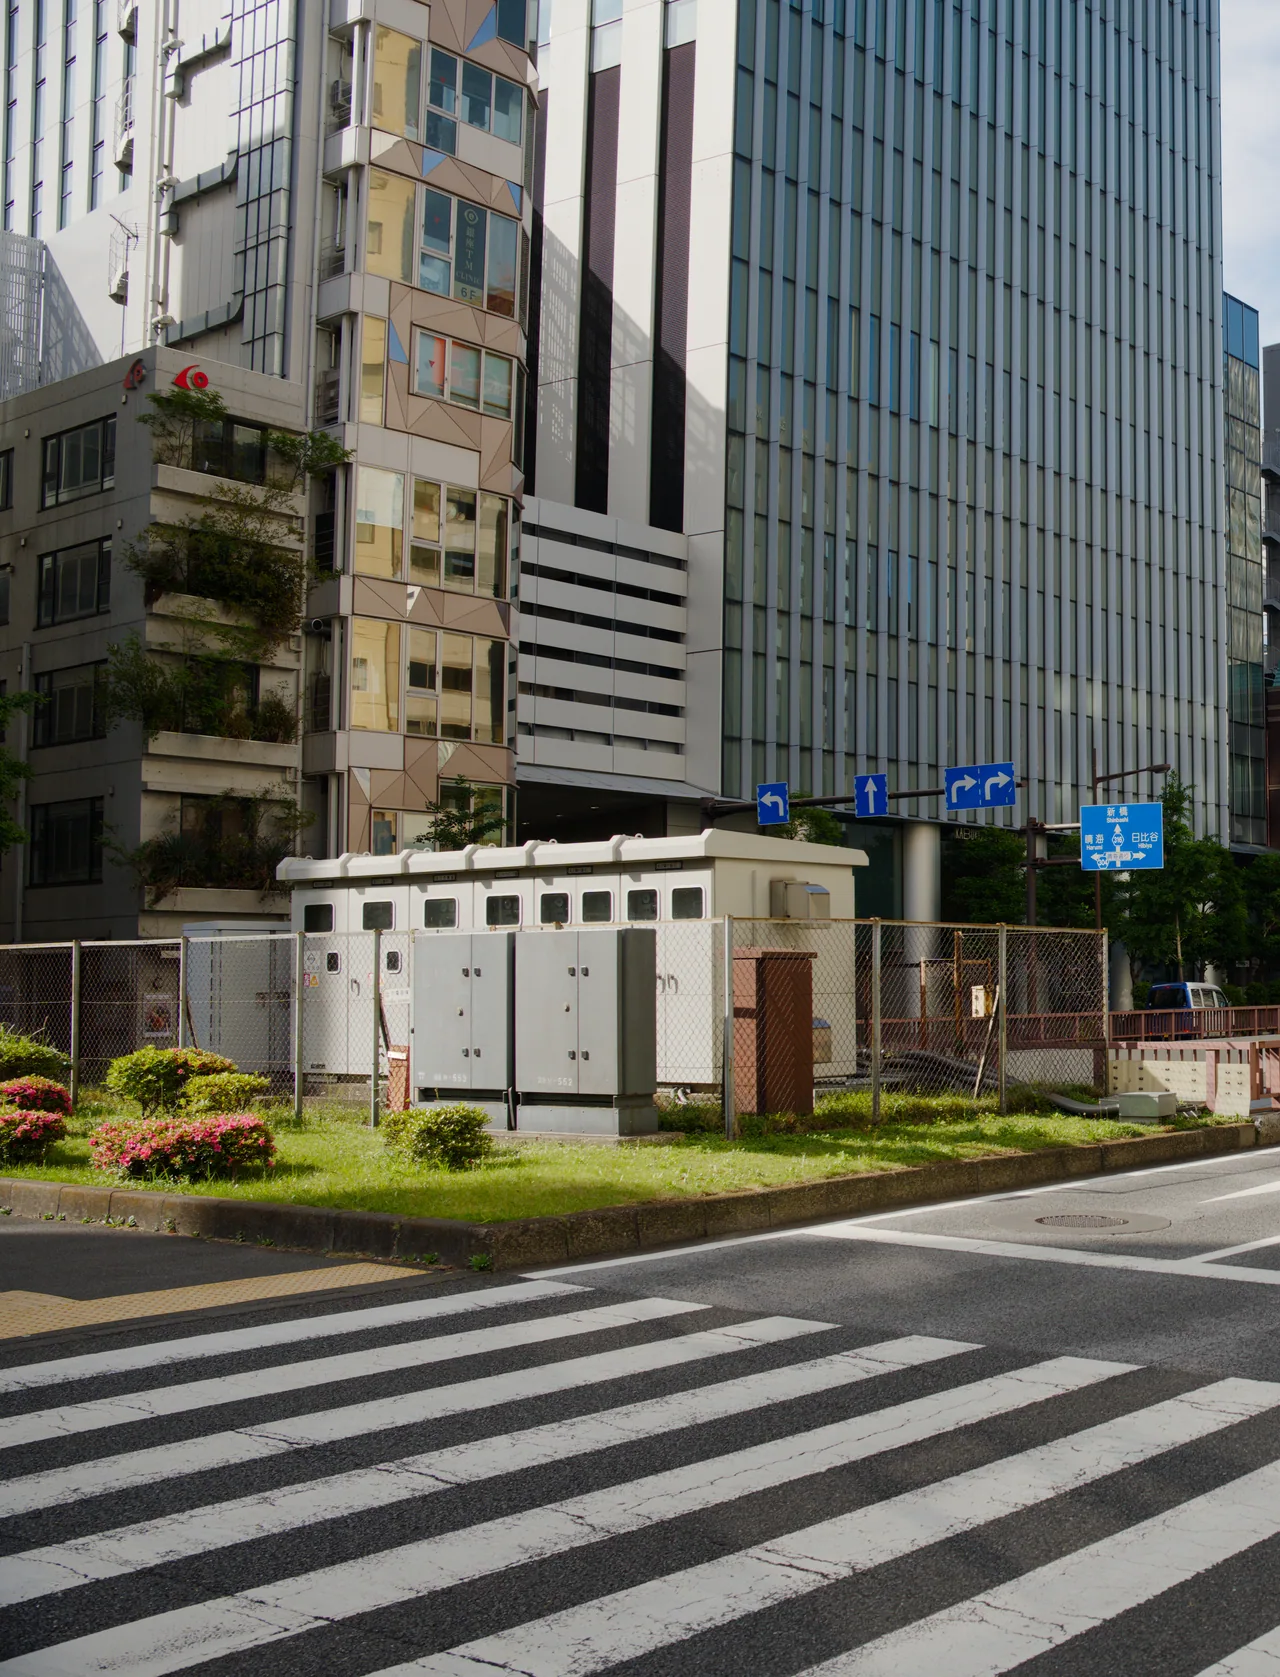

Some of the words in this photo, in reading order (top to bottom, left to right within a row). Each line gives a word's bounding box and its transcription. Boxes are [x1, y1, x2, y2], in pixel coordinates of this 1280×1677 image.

[461, 286, 477, 300] 6F
[1106, 806, 1128, 817] 新橋
[1084, 834, 1104, 844] 晴海
[1131, 832, 1159, 842] 日比谷
